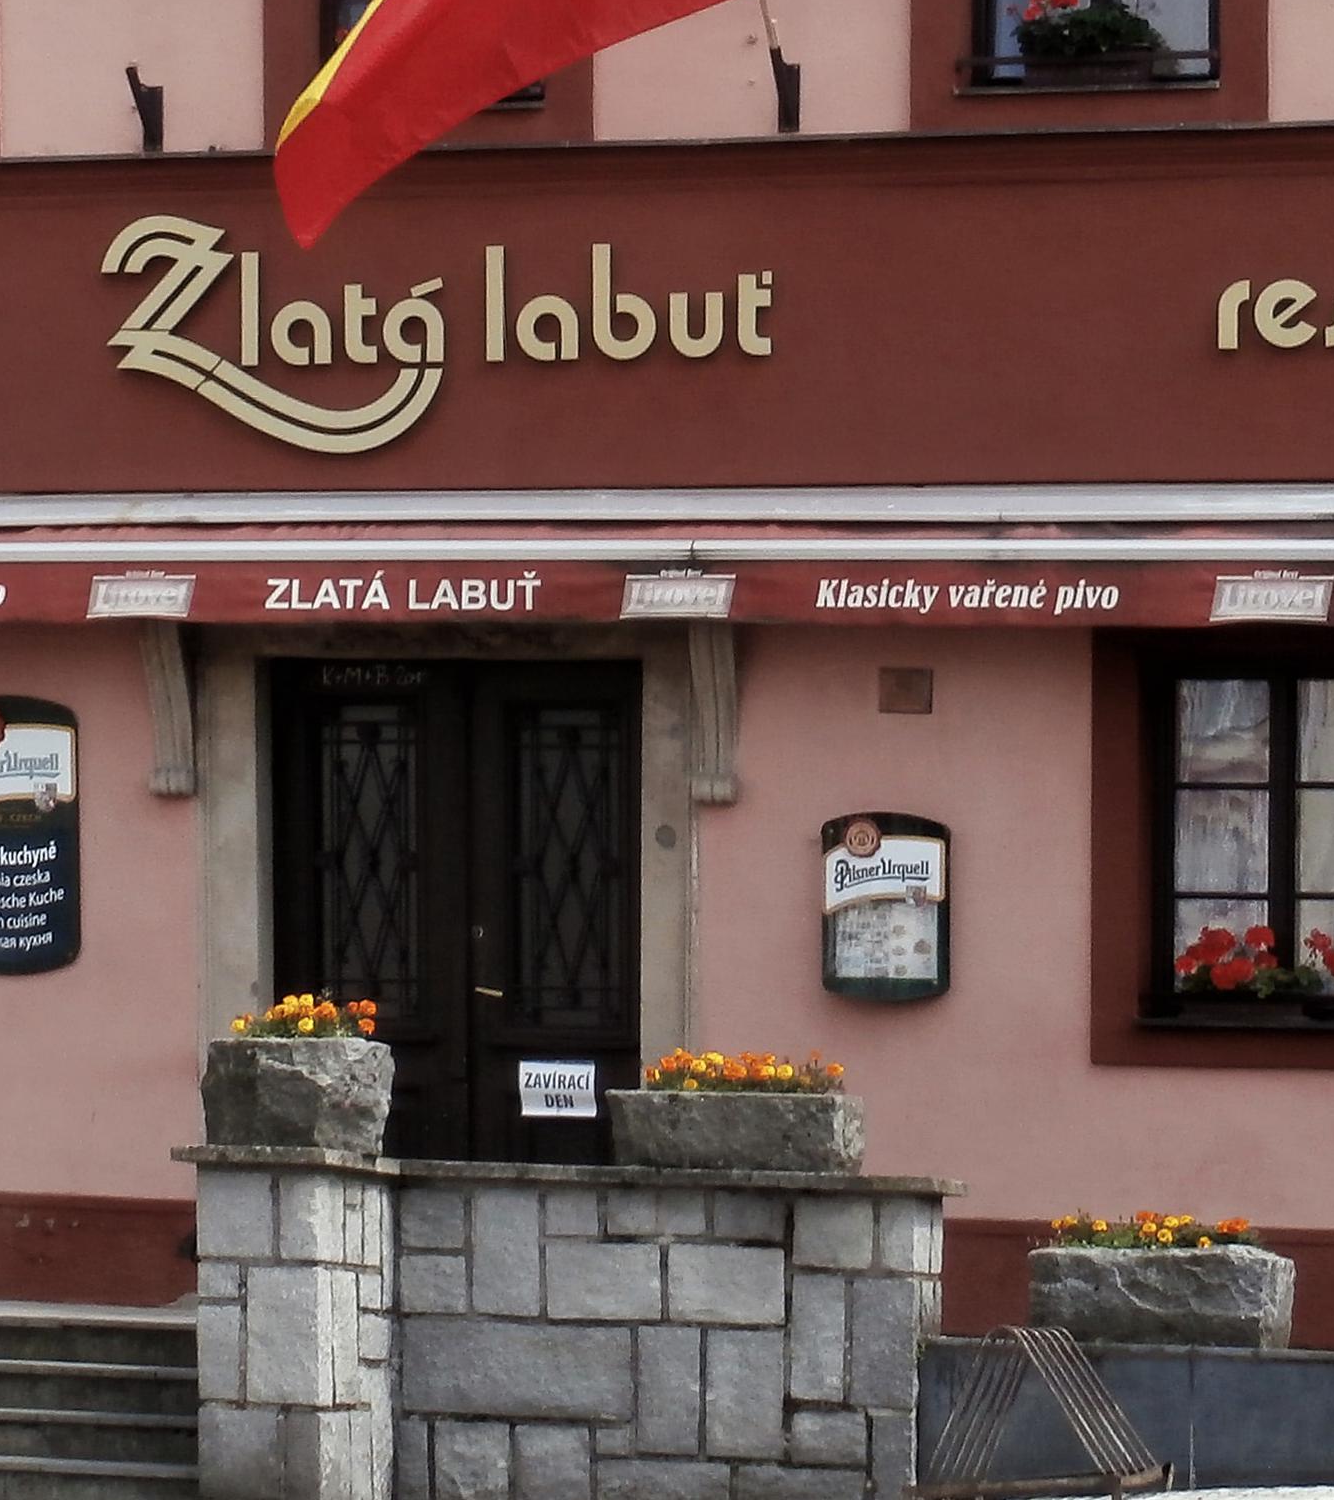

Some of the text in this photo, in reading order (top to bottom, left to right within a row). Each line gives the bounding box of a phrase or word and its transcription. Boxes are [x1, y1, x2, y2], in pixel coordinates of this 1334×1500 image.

[101, 214, 773, 454] Zlatá labuť
[265, 571, 542, 611] ZLATÁ LABUŤ
[815, 578, 1120, 615] Klasicky vařené pivo
[4, 750, 59, 780] Urquell
[0, 840, 57, 868] kuchyně
[12, 869, 51, 887] czeska
[834, 858, 930, 893] Pilsner Urquell
[6, 912, 47, 929] cuisine
[524, 1071, 591, 1091] ZAVÍRACÍ
[544, 1094, 575, 1109] DEN
